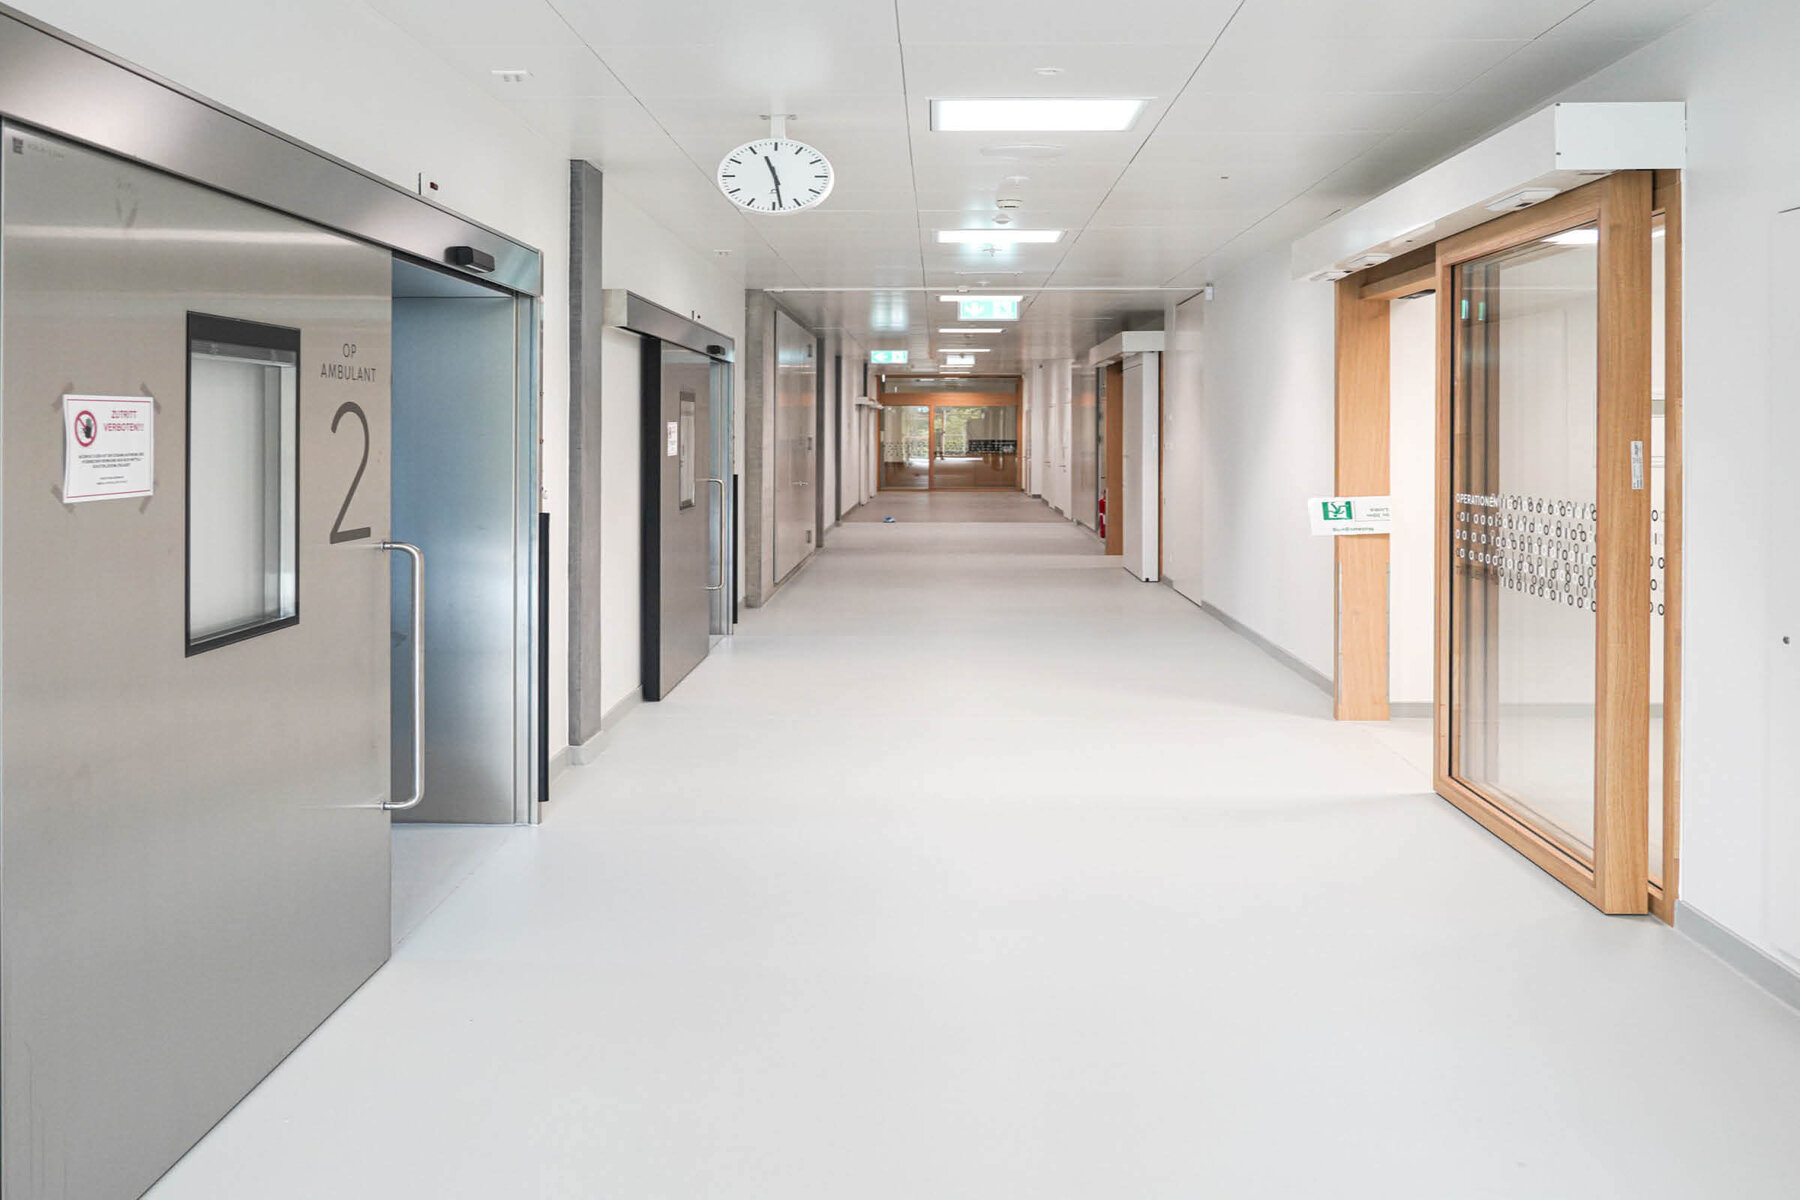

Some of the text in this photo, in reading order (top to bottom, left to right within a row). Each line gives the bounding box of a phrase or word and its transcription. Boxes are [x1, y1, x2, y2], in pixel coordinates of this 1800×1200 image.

[342, 343, 357, 359] OP
[320, 362, 377, 383] AMBULANT
[111, 410, 138, 419] ZUTRITT
[329, 401, 371, 545] 2
[1456, 493, 1499, 508] OPERATIONEN
